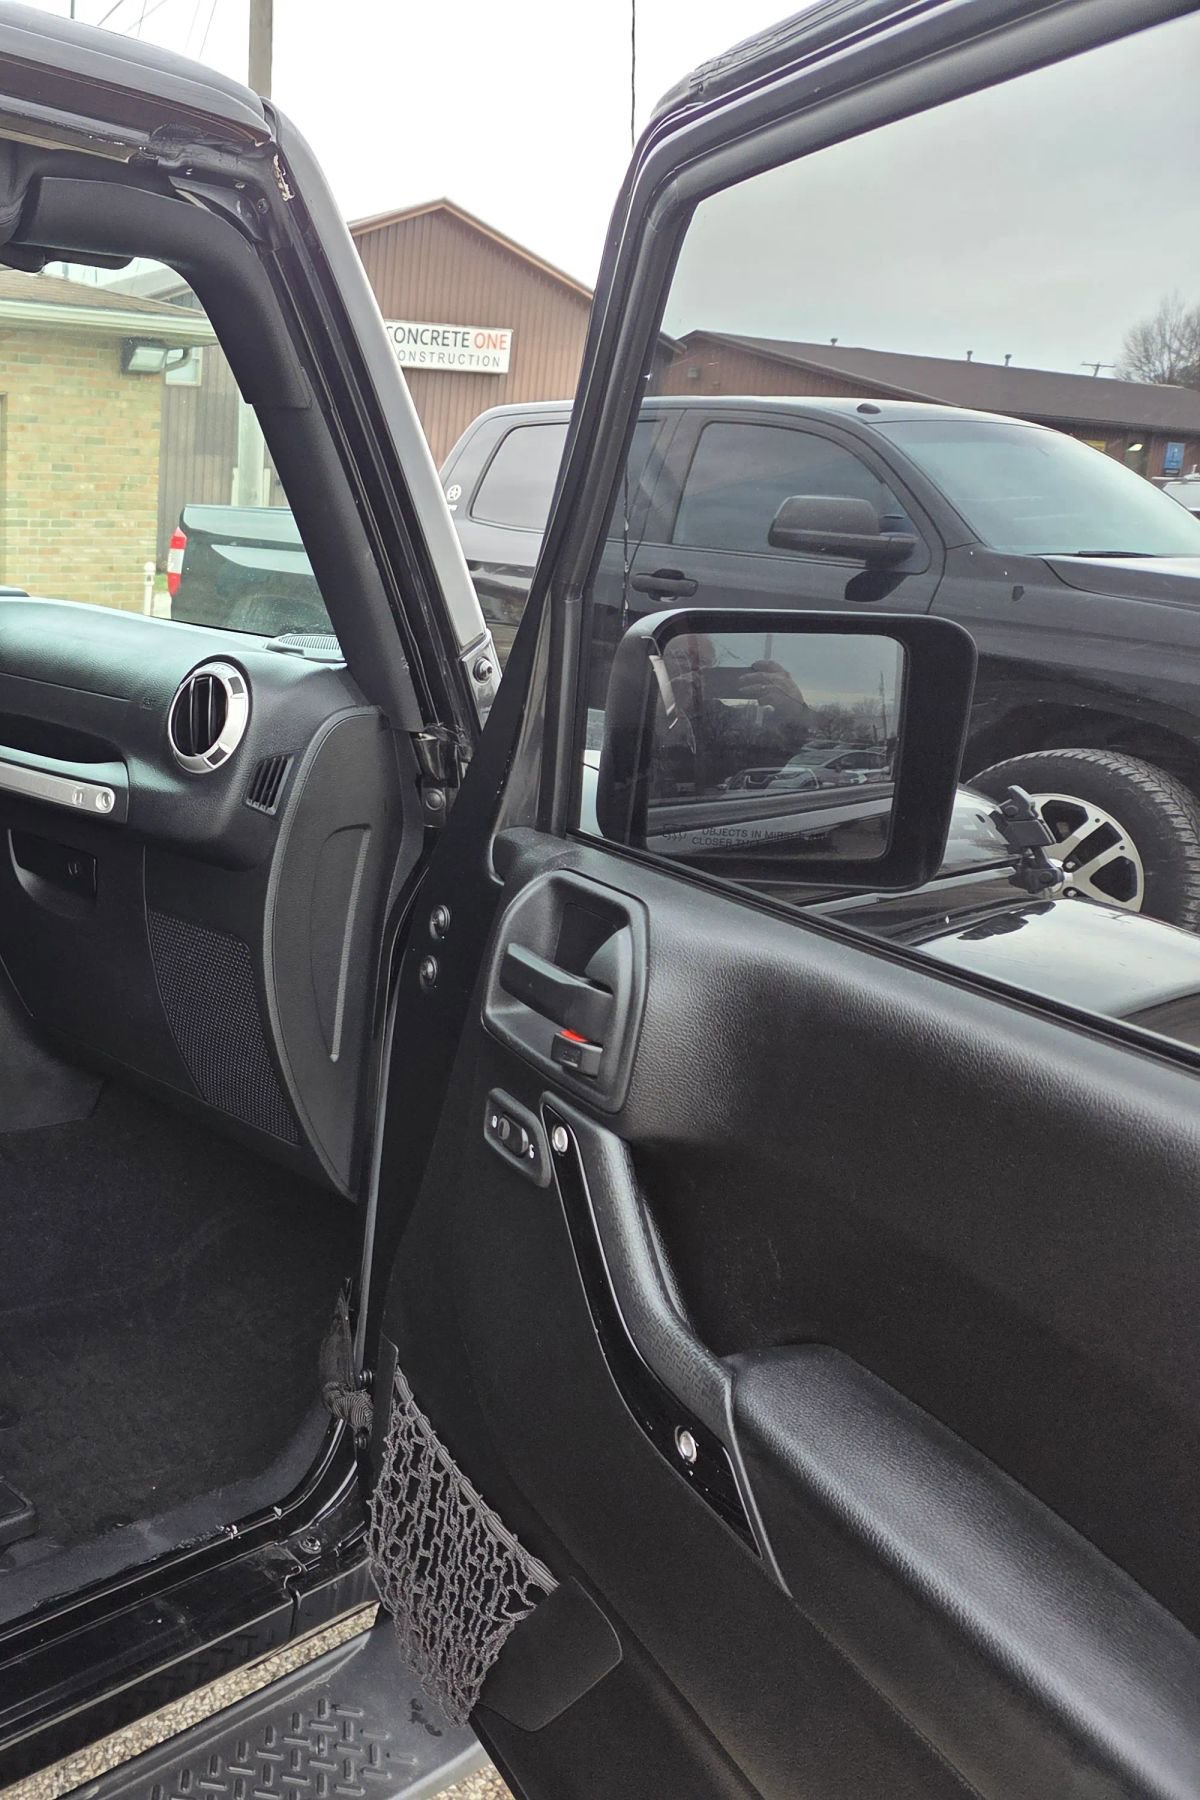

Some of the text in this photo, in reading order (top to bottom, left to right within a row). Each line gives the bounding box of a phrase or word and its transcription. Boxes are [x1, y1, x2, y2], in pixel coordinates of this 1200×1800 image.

[473, 332, 508, 351] ONE
[398, 350, 501, 368] ONSTRUCTION
[691, 836, 732, 848] CLOSER
